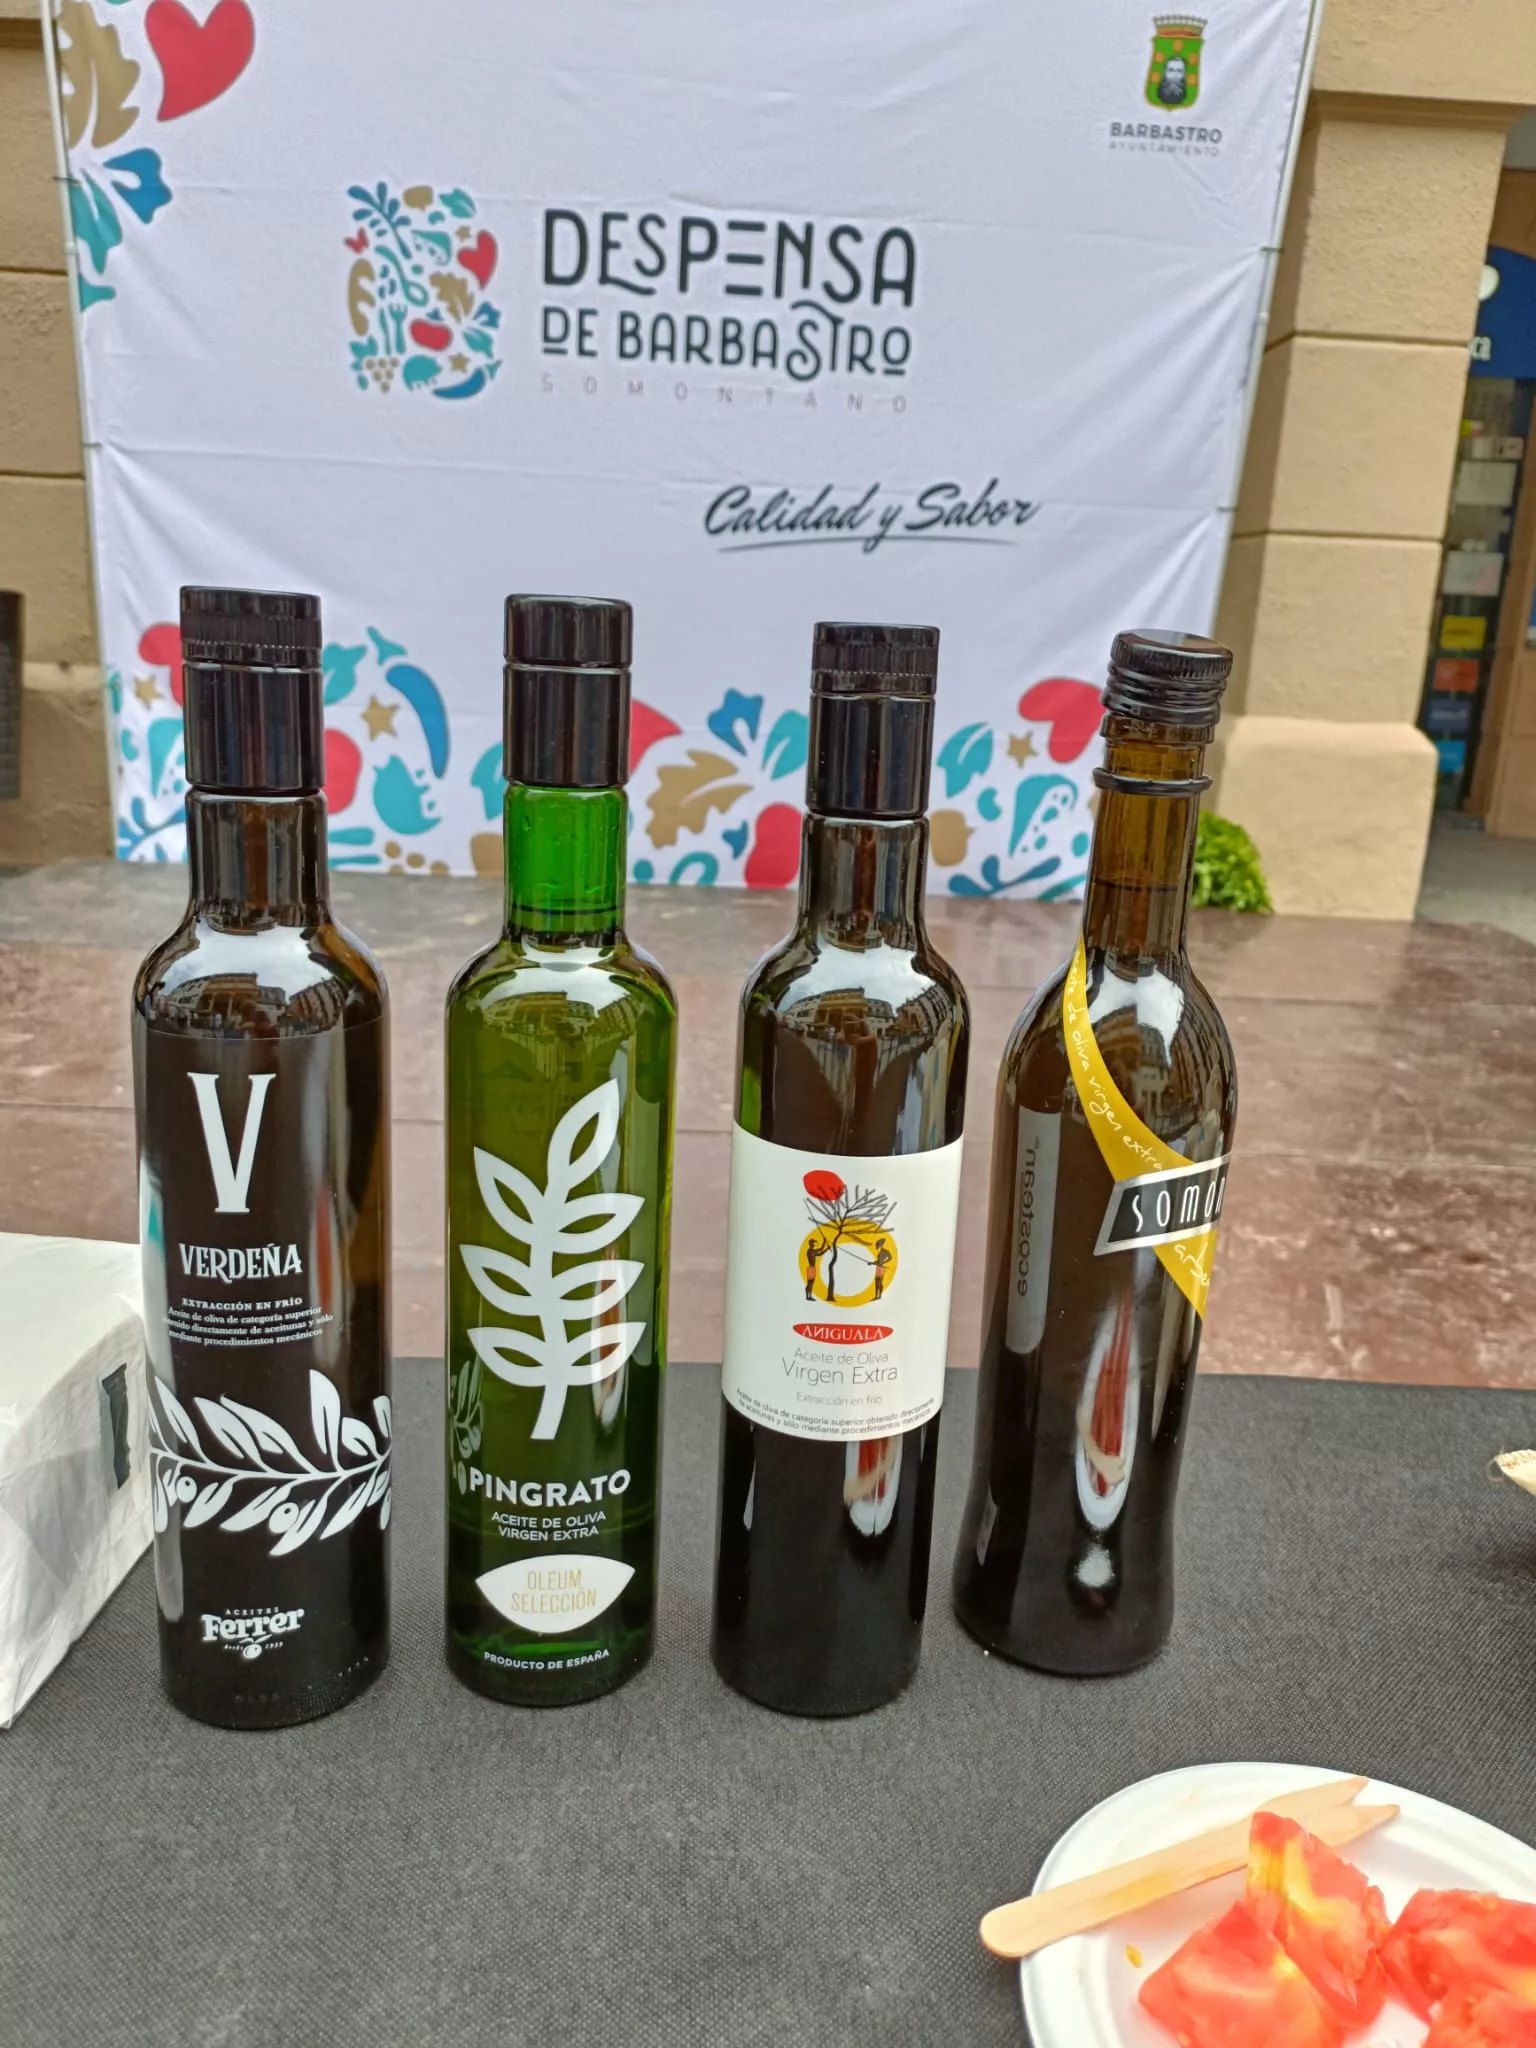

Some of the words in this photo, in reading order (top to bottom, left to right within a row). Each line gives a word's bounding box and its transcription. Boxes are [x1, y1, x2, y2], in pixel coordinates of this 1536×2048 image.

[1110, 122, 1223, 144] BARBASTRO
[544, 208, 917, 308] DESPENSA
[542, 306, 599, 356] DE
[617, 299, 913, 381] BARBASTRO
[541, 375, 908, 414] SOMONTANO
[704, 482, 880, 537] Calidad
[864, 504, 903, 553] y
[904, 477, 1042, 532] Sabor
[1067, 1002, 1087, 1024] de
[1072, 1030, 1090, 1071] oliva
[1089, 1076, 1122, 1131] virgen
[187, 1072, 277, 1213] V
[1123, 1135, 1163, 1170] extra
[178, 1243, 303, 1283] VERDEÑA
[182, 1298, 252, 1311] EXTRACCIÓN
[255, 1301, 272, 1310] EN
[275, 1297, 303, 1308] FRÍO
[168, 1307, 190, 1319] Aceite
[192, 1312, 203, 1321] de
[204, 1314, 225, 1323] oliva
[227, 1315, 239, 1324] de
[241, 1313, 282, 1325] categoría
[285, 1306, 322, 1320] superior
[192, 1323, 248, 1335] directamente
[250, 1325, 262, 1334] de
[264, 1322, 306, 1334] aceitunas
[308, 1319, 314, 1328] y
[316, 1313, 333, 1323] sólo
[169, 1329, 202, 1343] mediante
[204, 1336, 274, 1346] procedimientos
[276, 1328, 323, 1343] mecánicos
[794, 1347, 834, 1364] Aceite
[837, 1352, 854, 1365] de
[857, 1351, 889, 1365] Oliva
[782, 1357, 844, 1387] Virgen
[852, 1366, 898, 1384] Extra
[796, 1391, 848, 1407] Extracción
[850, 1397, 863, 1406] en
[762, 1403, 778, 1415] oliva
[780, 1409, 790, 1418] de
[831, 1417, 864, 1426] superior
[801, 1423, 841, 1433] mediante
[469, 1466, 632, 1507] PINGRATO
[491, 1511, 537, 1528] ACEITE
[542, 1518, 561, 1529] DE
[566, 1510, 606, 1527] OLIVA
[498, 1525, 548, 1541] VIRGEN
[553, 1525, 599, 1541] EXTRA
[527, 1569, 582, 1591] OLEUM
[511, 1584, 597, 1614] SELECCIÓN
[225, 1606, 279, 1616] ACEITES
[201, 1608, 305, 1641] Ferrer
[484, 1651, 544, 1669] PRODUCTO
[548, 1659, 564, 1669] DE
[566, 1649, 610, 1668] ESPAÑA
